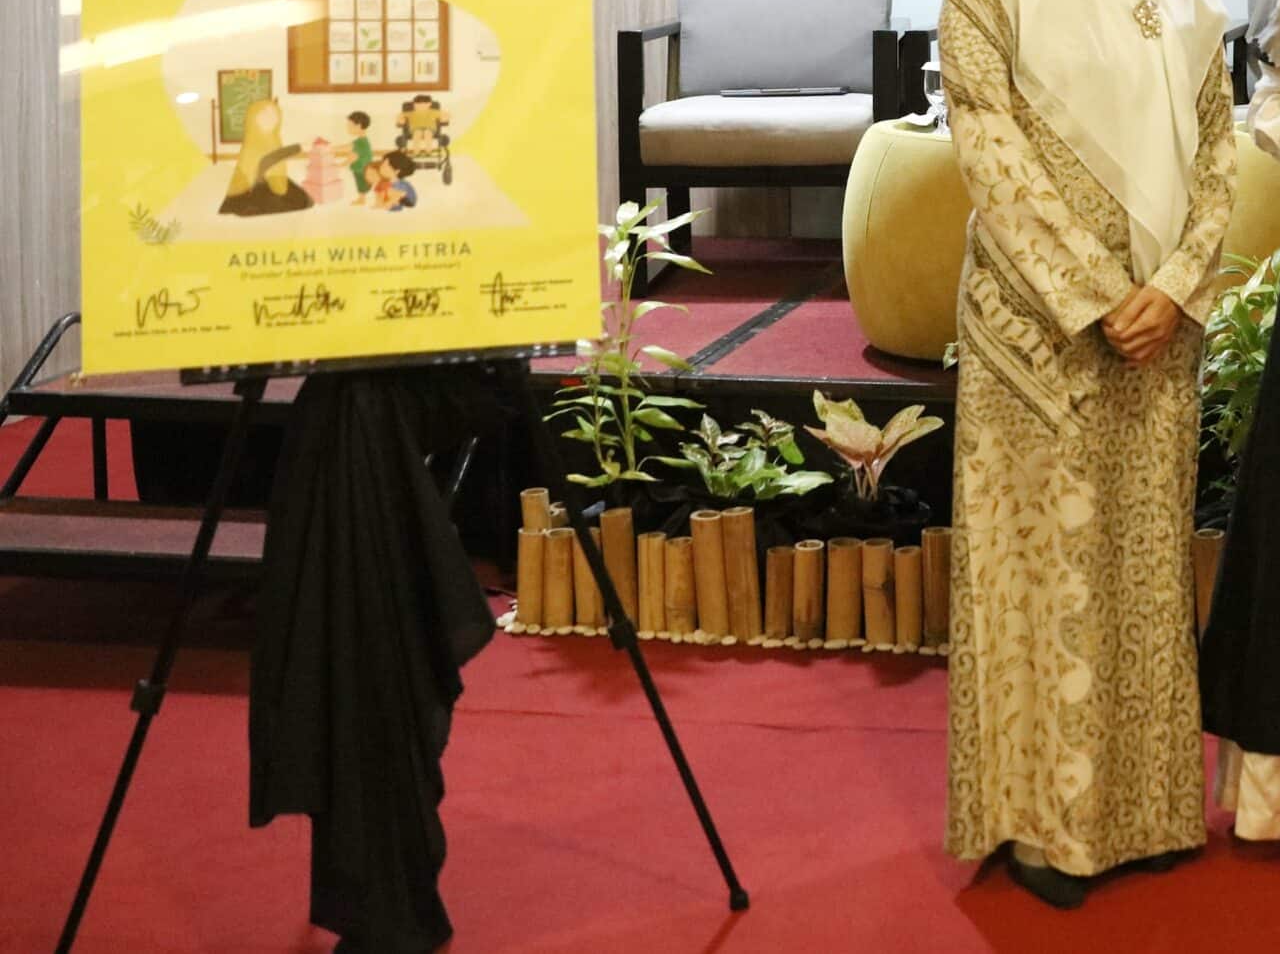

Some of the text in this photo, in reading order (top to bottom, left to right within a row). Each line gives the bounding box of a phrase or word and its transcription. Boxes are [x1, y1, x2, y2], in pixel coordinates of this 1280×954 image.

[228, 242, 472, 267] ADILAH WINA FITRIA
